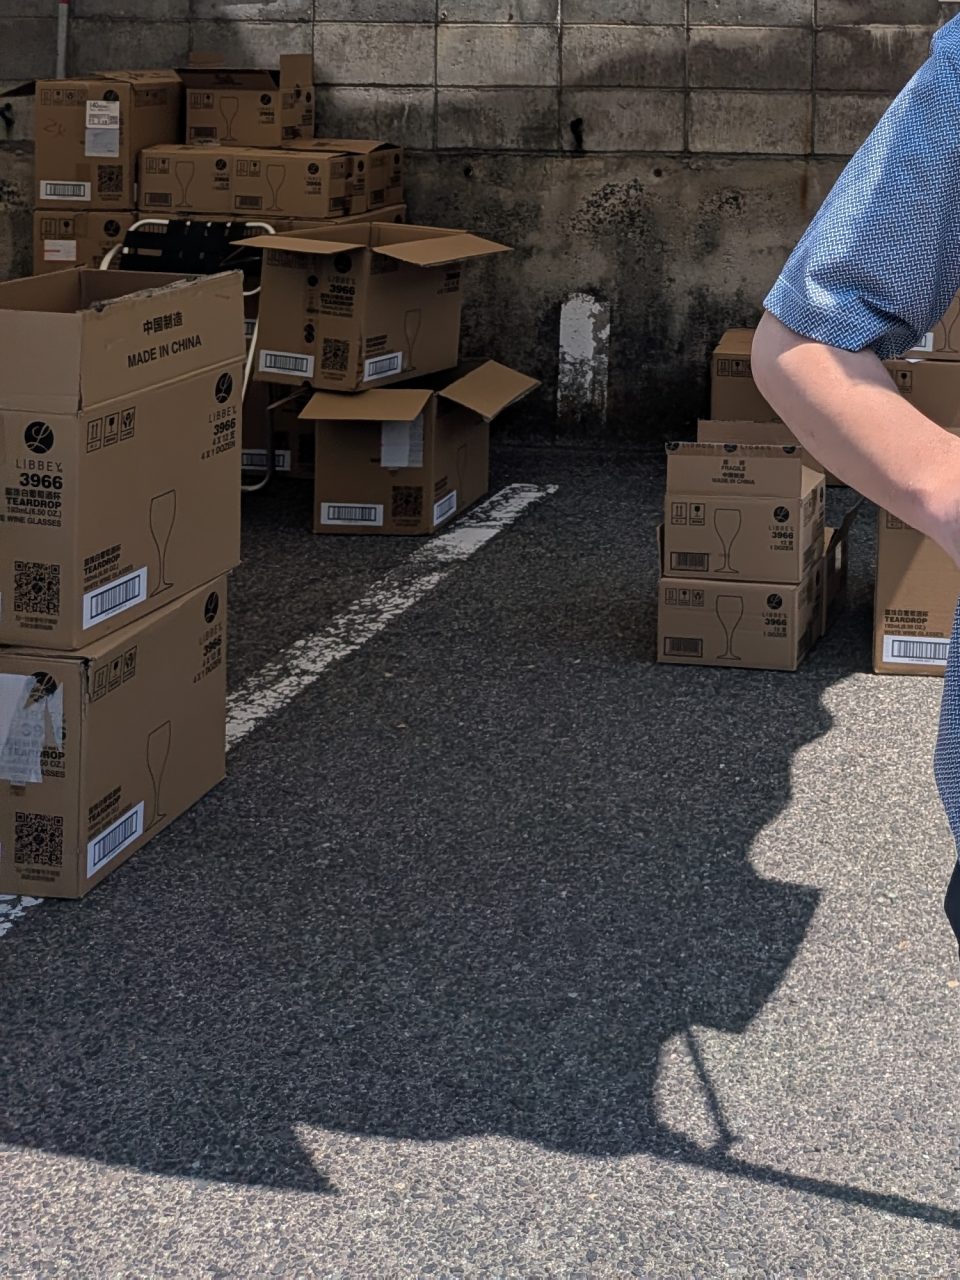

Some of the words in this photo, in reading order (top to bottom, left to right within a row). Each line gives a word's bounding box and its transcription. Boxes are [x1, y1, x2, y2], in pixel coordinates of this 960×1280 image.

[128, 348, 157, 368] MADE
[159, 344, 169, 359] IN
[171, 334, 202, 355] CHINA
[213, 418, 236, 436] 3966
[16, 458, 62, 472] LIBBEY
[19, 472, 63, 490] 3966
[6, 497, 62, 509] TEARDROP
[885, 616, 928, 625] TEARDROP
